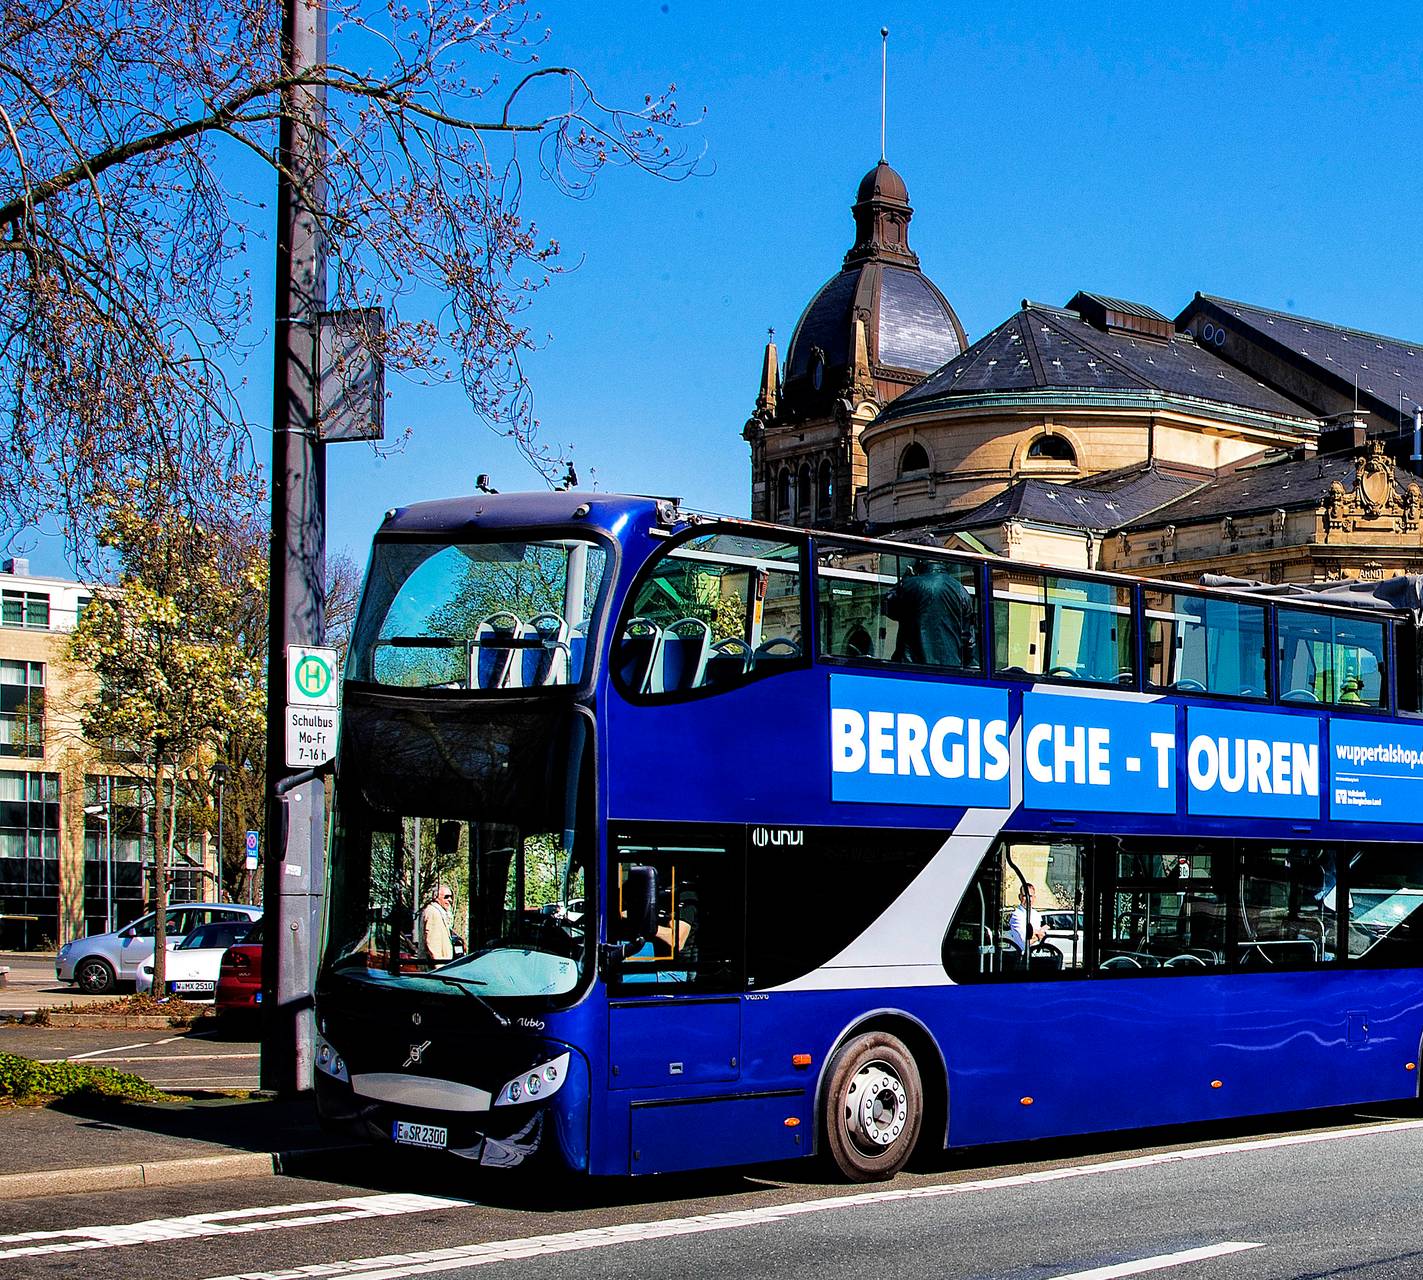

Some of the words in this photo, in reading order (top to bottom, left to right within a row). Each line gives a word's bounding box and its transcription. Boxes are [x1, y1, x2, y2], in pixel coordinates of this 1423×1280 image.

[1360, 568, 1385, 580] ARNDT
[292, 714, 333, 728] Schulbus
[299, 732, 326, 744] Mo-Fr
